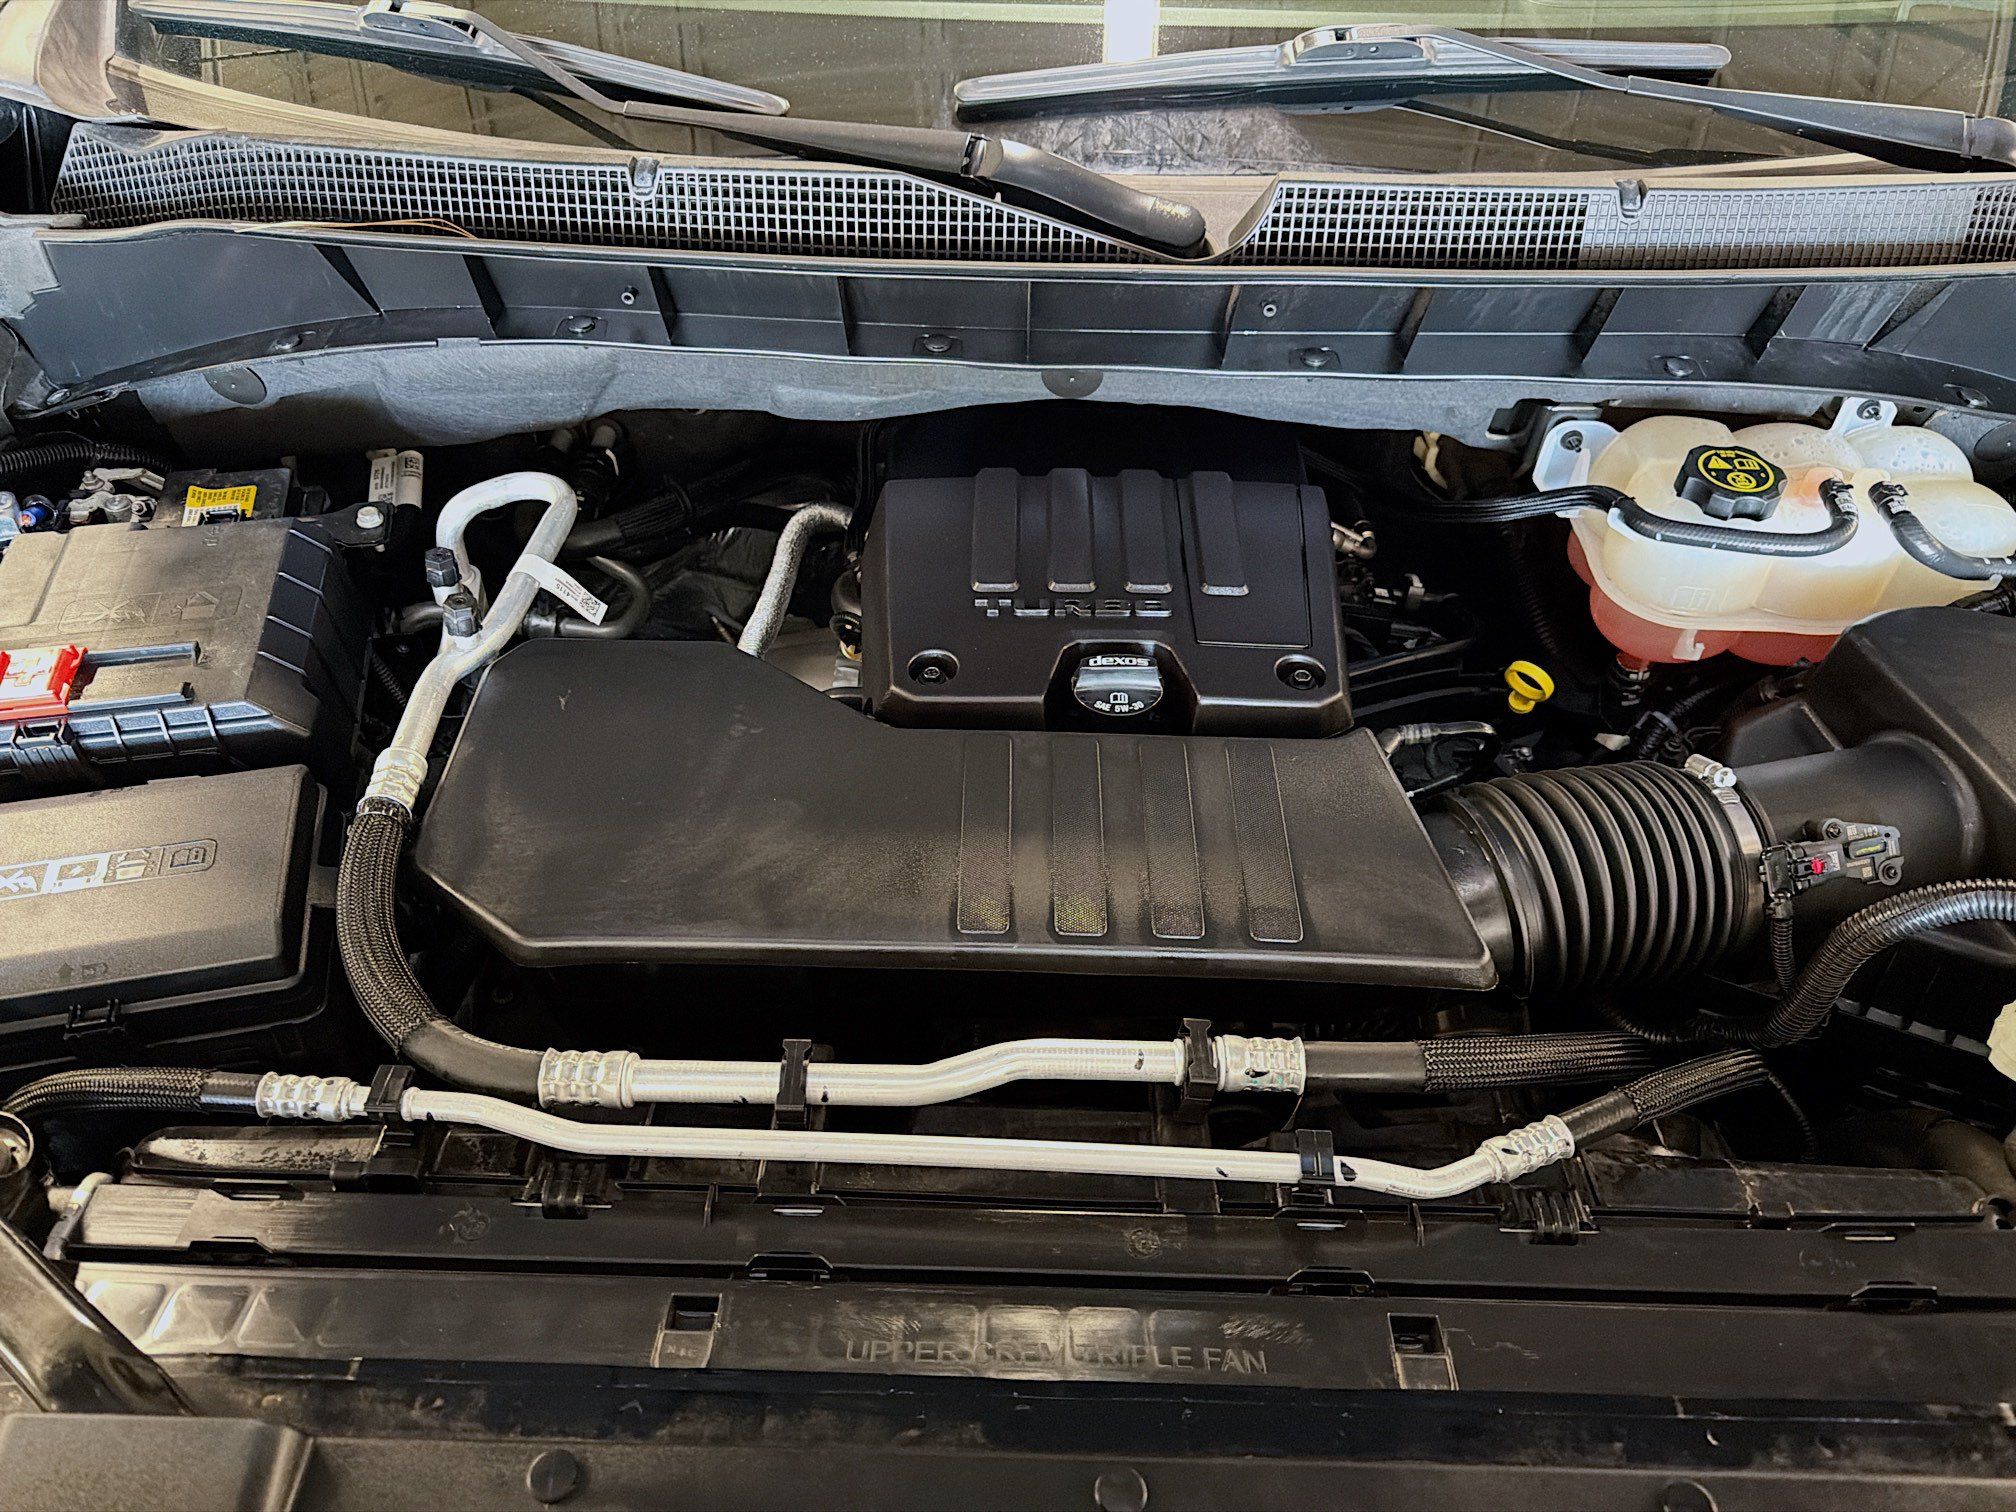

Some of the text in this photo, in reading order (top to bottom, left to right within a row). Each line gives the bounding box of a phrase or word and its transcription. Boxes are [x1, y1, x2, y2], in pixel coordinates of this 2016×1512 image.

[1088, 655, 1152, 667] dexos
[1093, 700, 1145, 713] SAE 5W-30
[846, 1340, 962, 1363] UPPER
[1073, 1343, 1194, 1370] TRIPLE
[1203, 1347, 1268, 1375] FAN
